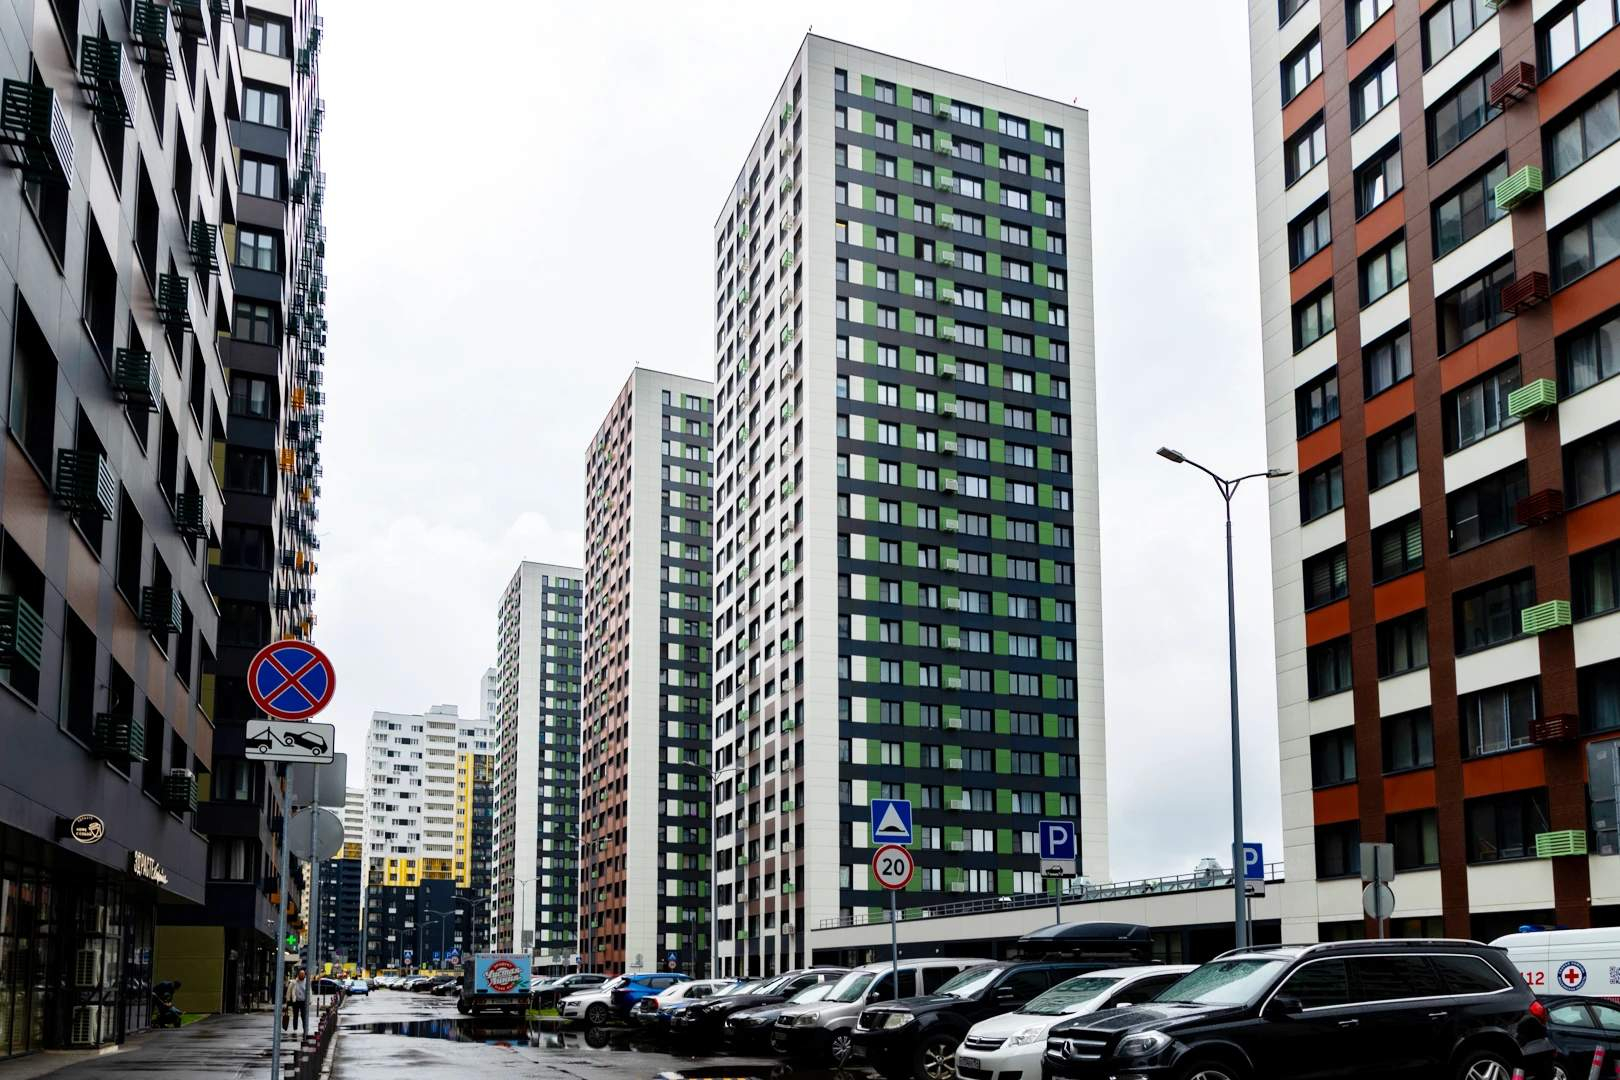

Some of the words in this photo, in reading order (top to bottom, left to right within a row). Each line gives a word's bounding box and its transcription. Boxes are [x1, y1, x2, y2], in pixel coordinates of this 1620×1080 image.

[1049, 825, 1068, 855] P
[882, 858, 904, 876] 20
[1242, 847, 1259, 875] P
